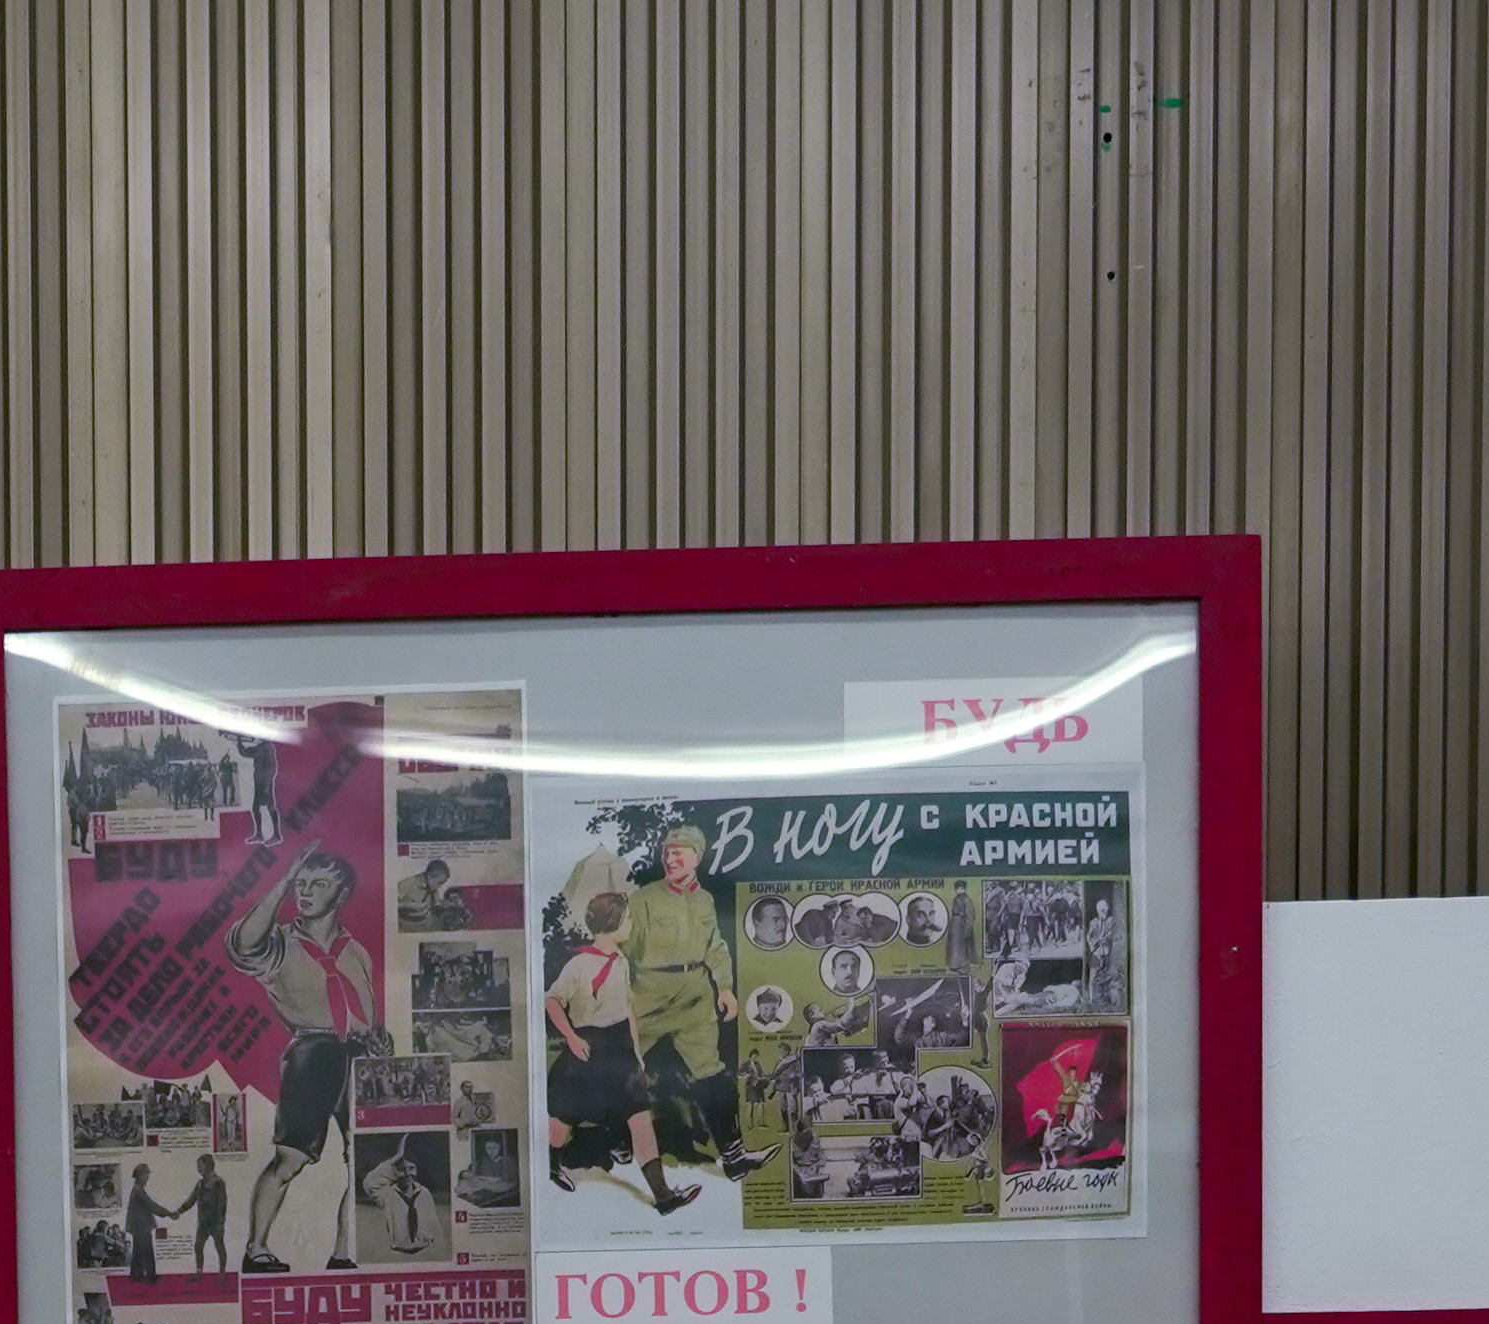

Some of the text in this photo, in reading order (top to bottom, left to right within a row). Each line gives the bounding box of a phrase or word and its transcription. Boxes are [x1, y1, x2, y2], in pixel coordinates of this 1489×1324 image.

[921, 697, 1090, 754] БУДЬ
[709, 805, 755, 875] В
[774, 799, 905, 873] ногу
[965, 795, 1118, 829] КРАСНОЙ
[960, 832, 1100, 867] АРМИЕЙ
[384, 1281, 497, 1302] ЧЕСТНО
[508, 1279, 526, 1300] И
[385, 1301, 526, 1321] НЕУКЛОННО
[555, 1269, 808, 1319] ГОТОВ !
